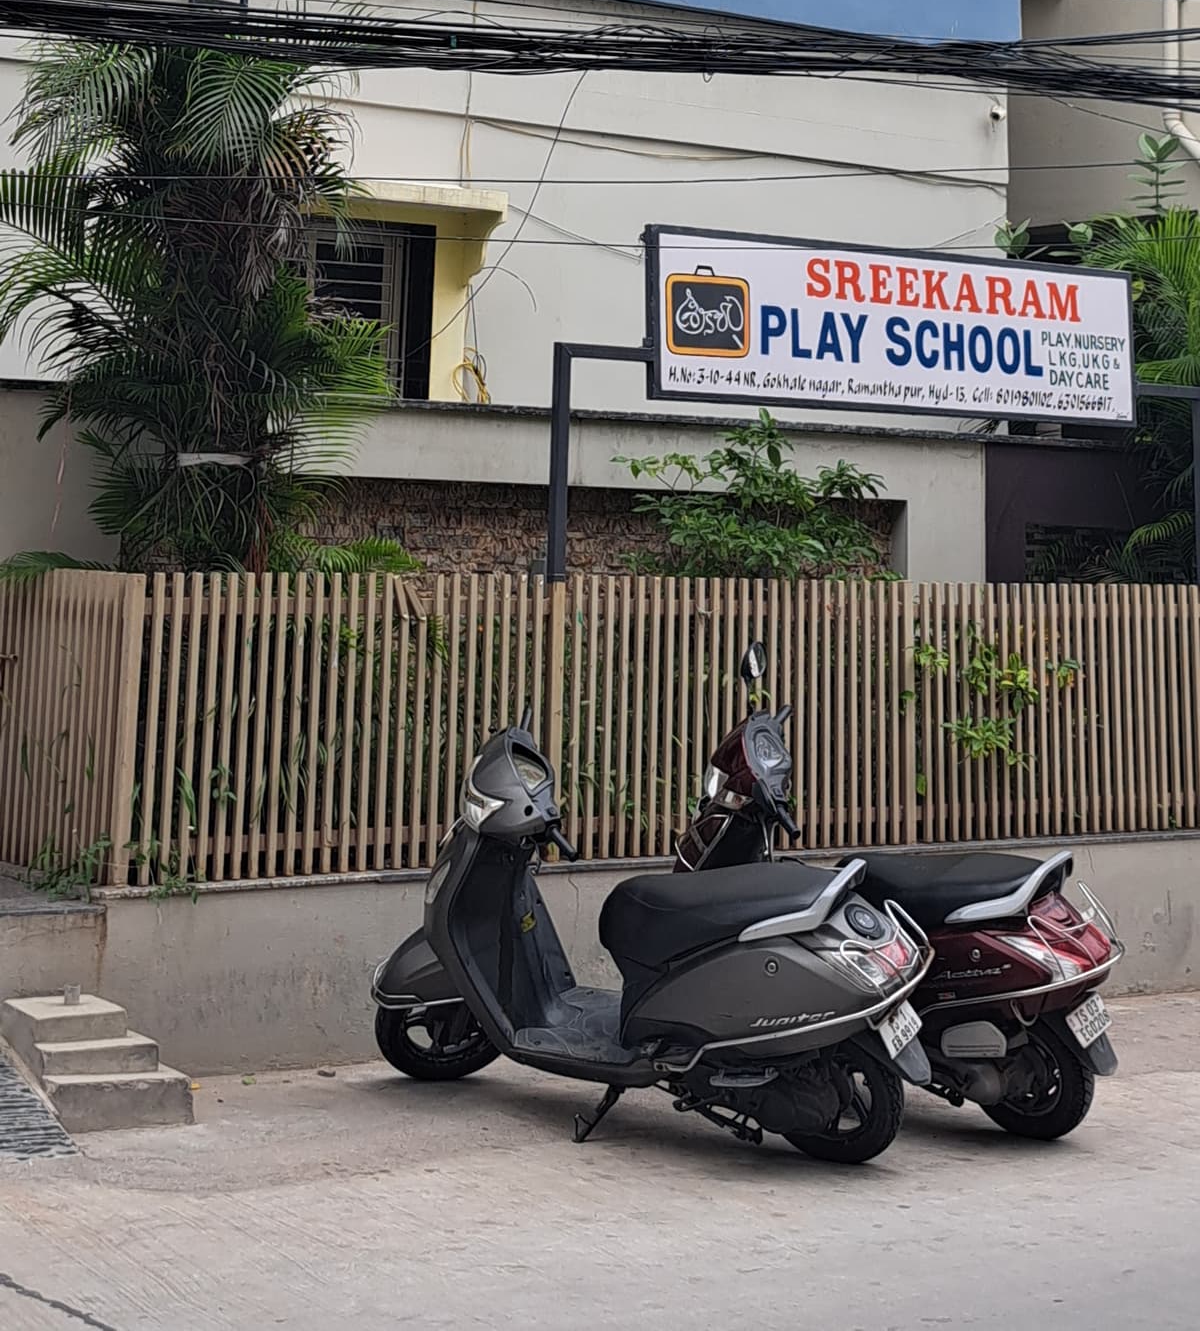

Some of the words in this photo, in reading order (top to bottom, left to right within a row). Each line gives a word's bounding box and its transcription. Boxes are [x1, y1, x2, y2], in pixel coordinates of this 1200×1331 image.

[806, 257, 1081, 322] SREEKARAM
[760, 305, 868, 363] PLAY
[885, 316, 1043, 377] SCHOOL
[1113, 358, 1120, 370] &
[763, 372, 806, 391] Gokhale
[749, 1011, 836, 1028] Jupiter
